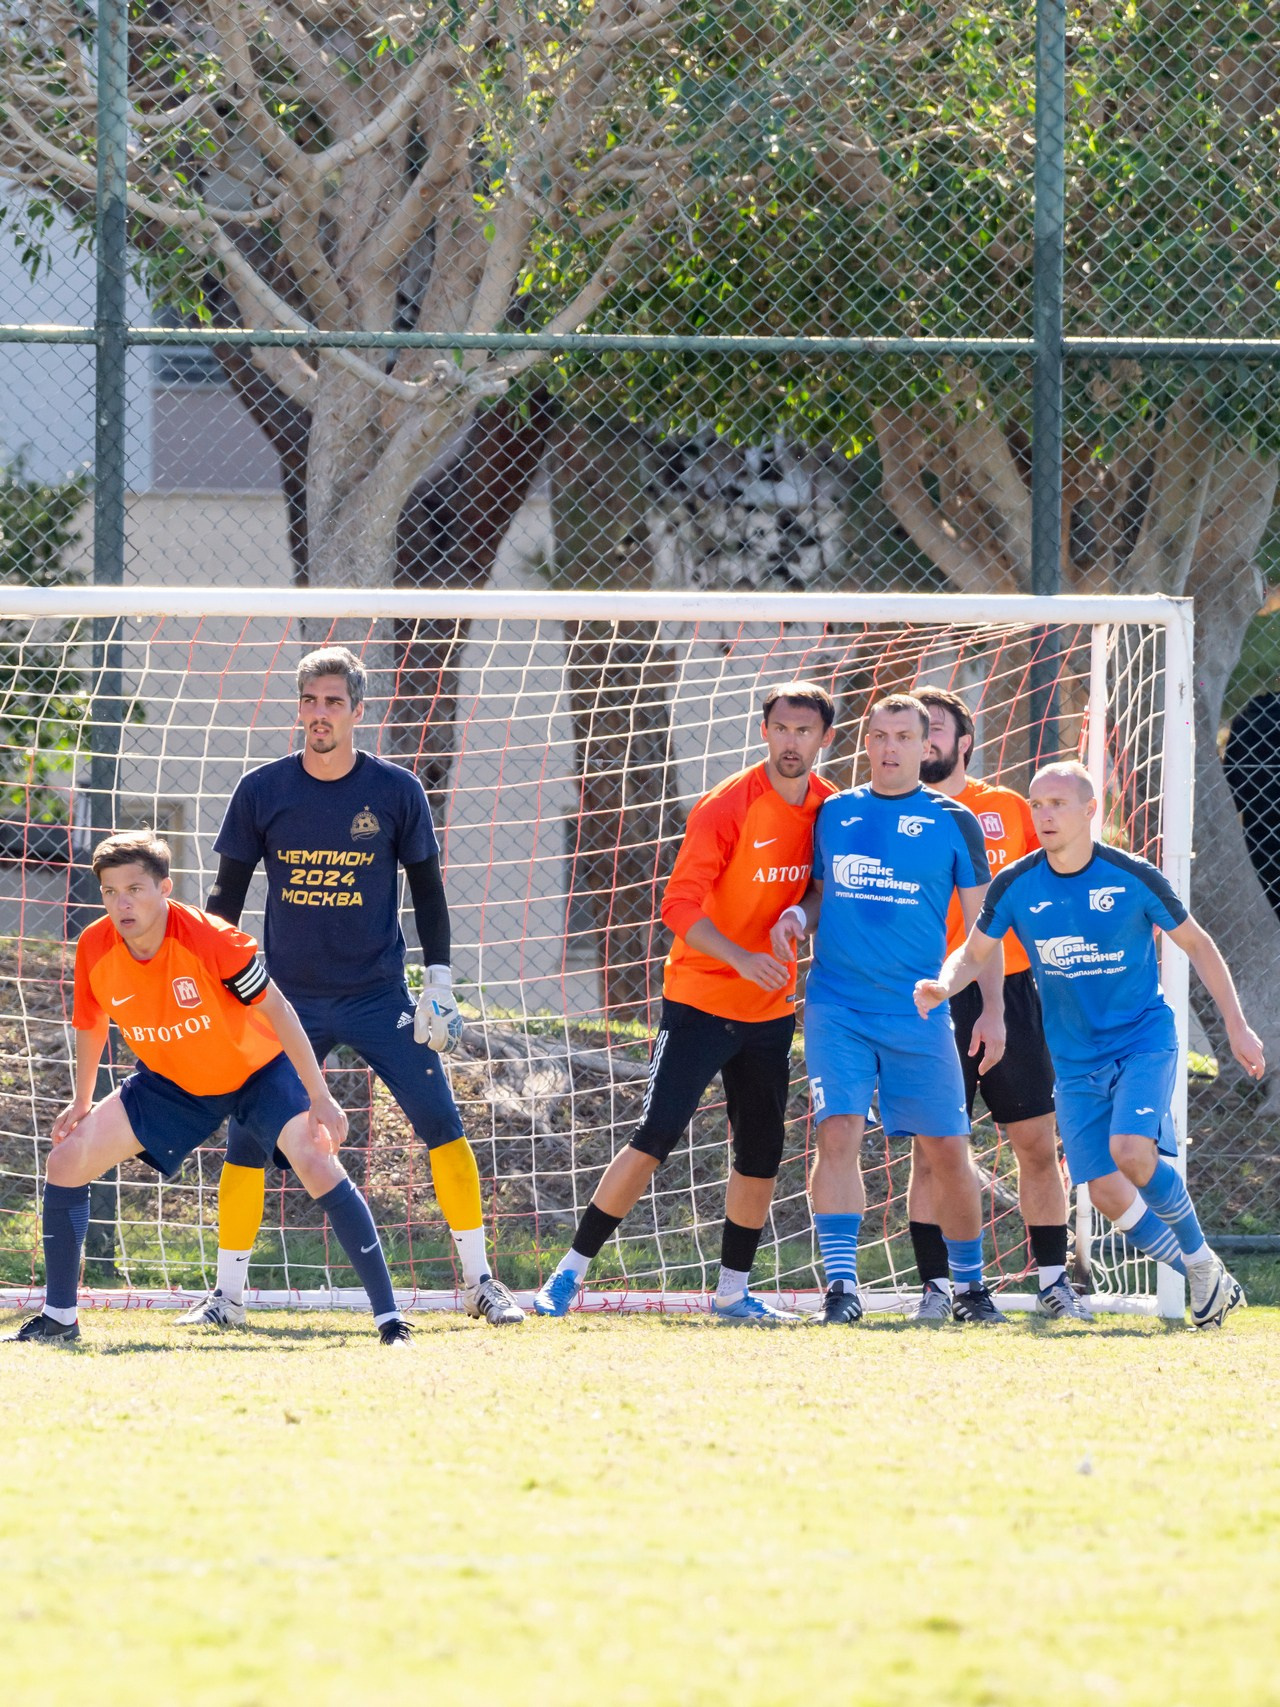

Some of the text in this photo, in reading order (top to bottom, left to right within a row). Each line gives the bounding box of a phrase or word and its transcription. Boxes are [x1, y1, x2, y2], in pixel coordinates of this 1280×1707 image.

[277, 850, 375, 866] ЧЕМПИОН
[289, 869, 356, 887] 2024
[752, 865, 812, 882] АВТОТ
[281, 888, 363, 907] МОСКВА
[854, 892, 894, 903] КОМПАНИЙ
[123, 1014, 211, 1042] АВТОТОР
